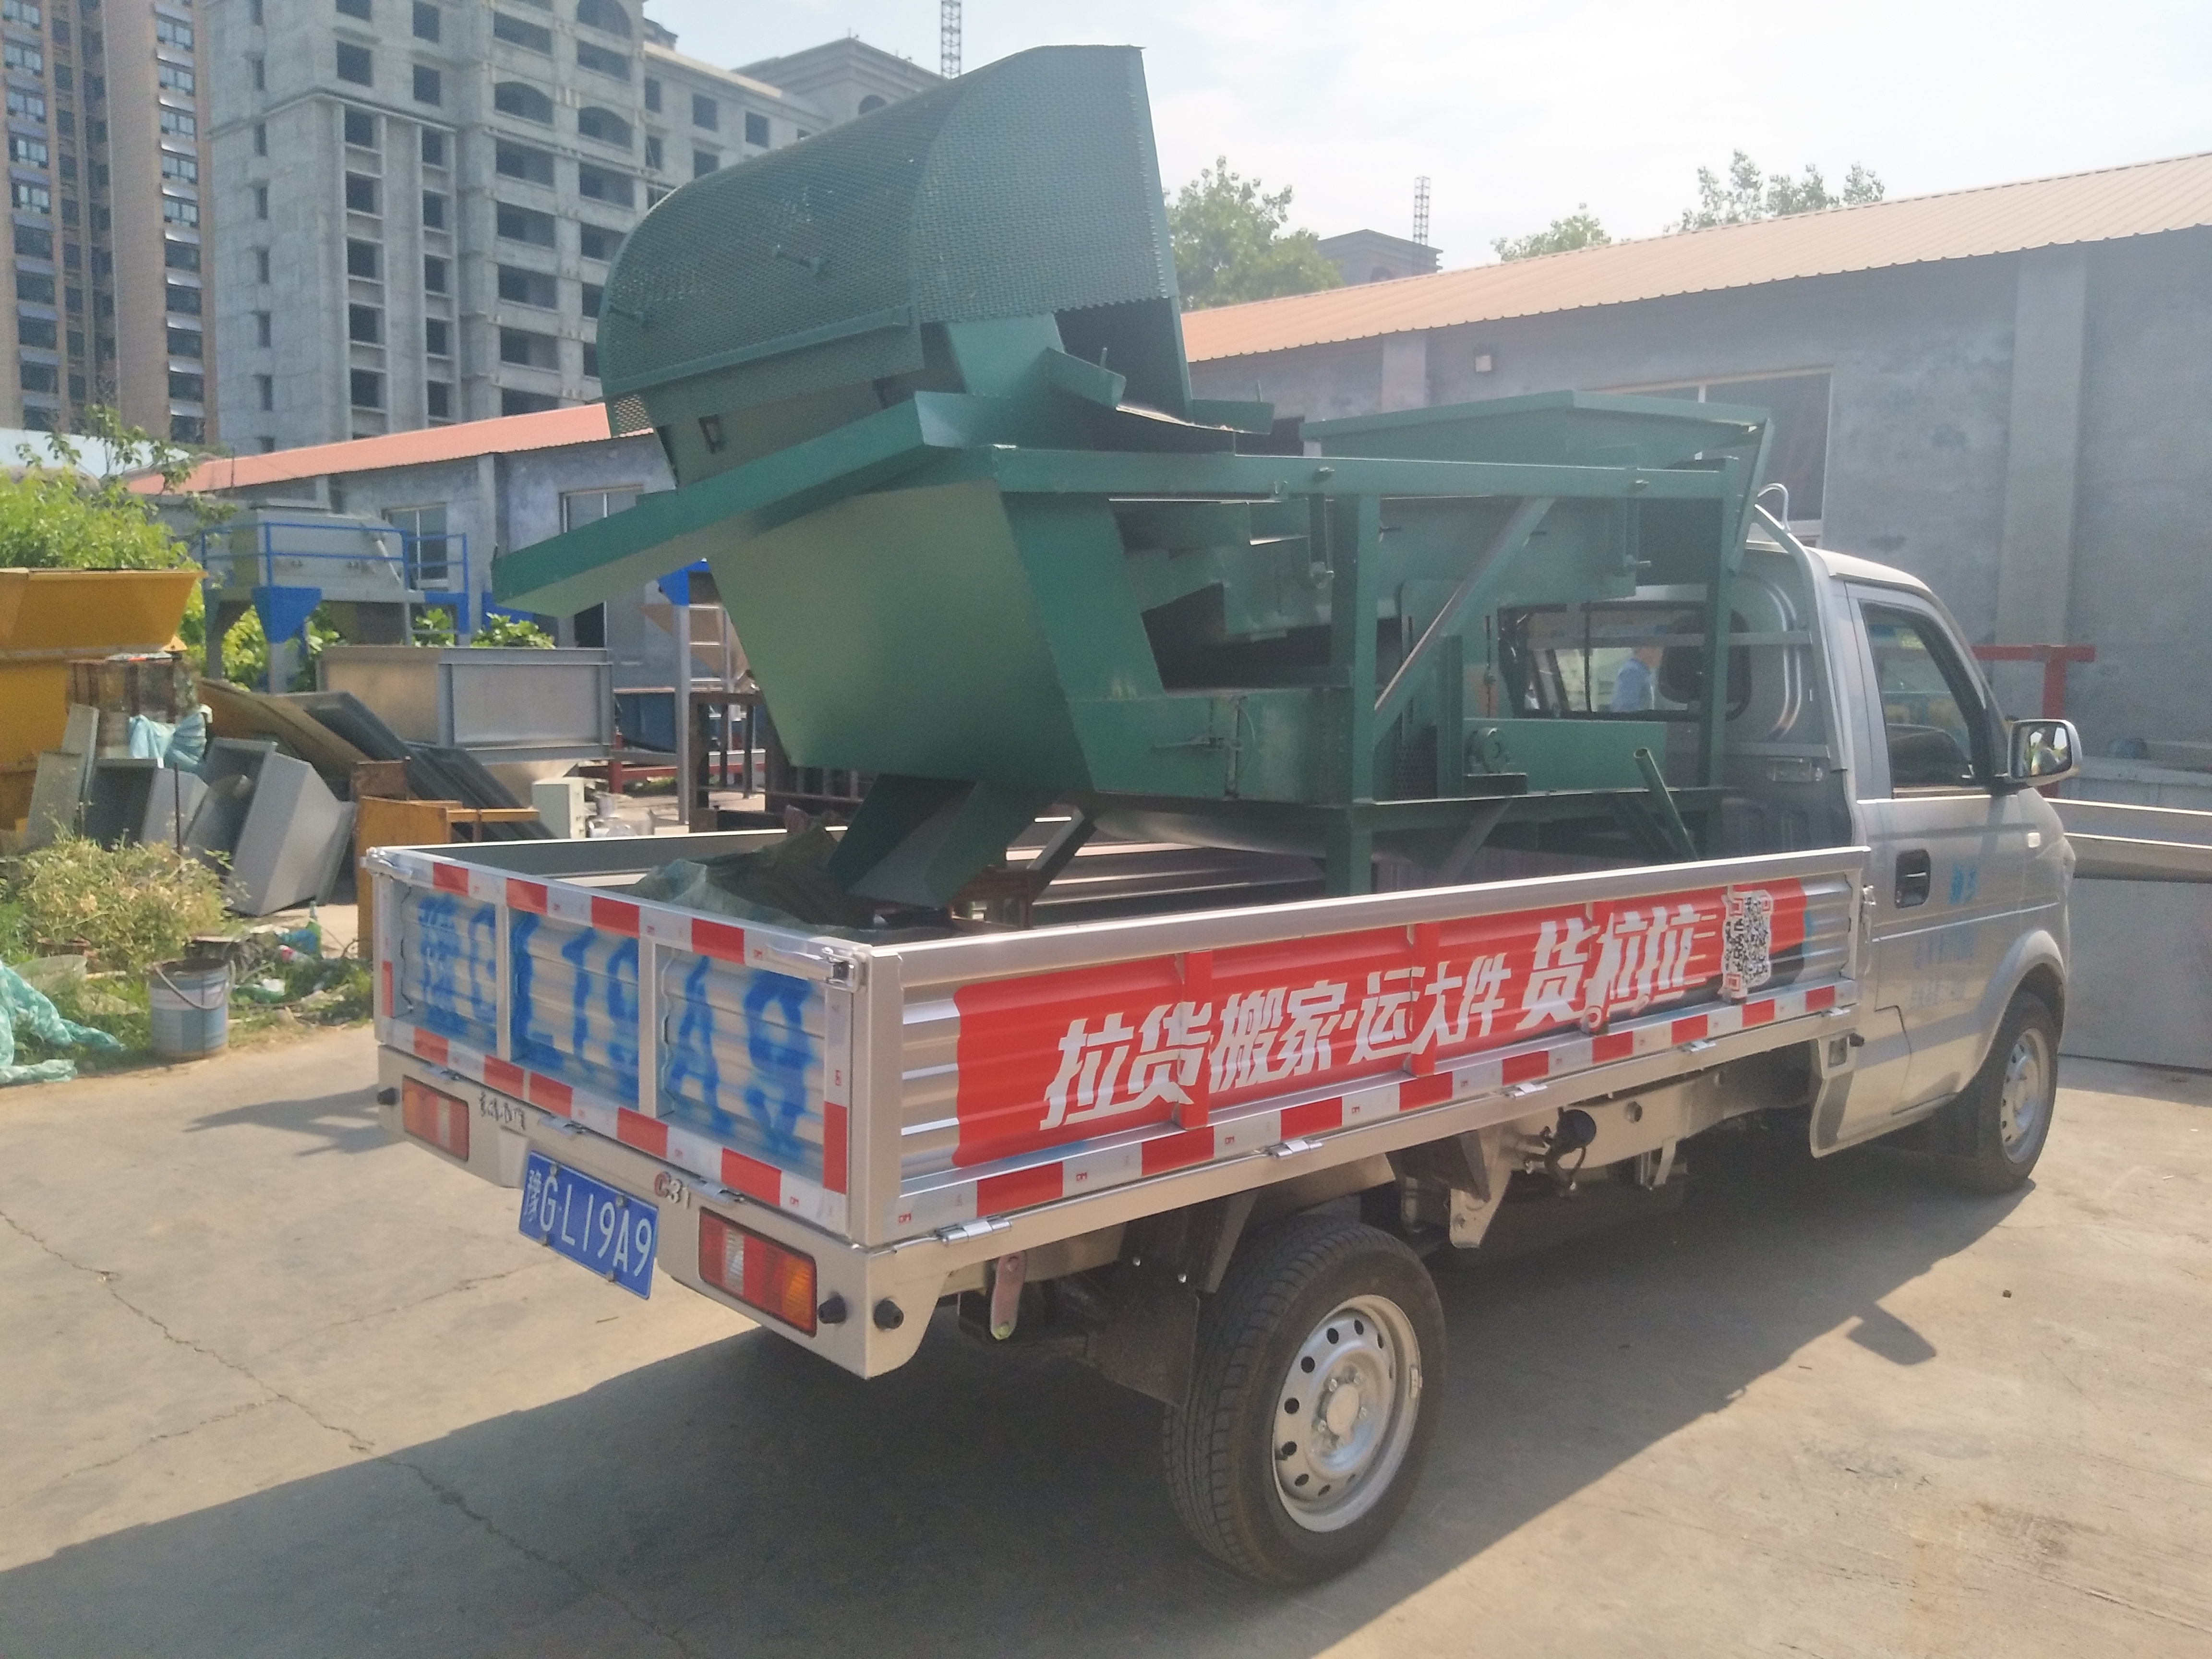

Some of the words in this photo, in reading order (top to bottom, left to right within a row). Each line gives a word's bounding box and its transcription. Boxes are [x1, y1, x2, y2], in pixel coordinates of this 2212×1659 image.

[1515, 904, 1707, 1029] 货拉拉
[654, 1171, 690, 1209] C31
